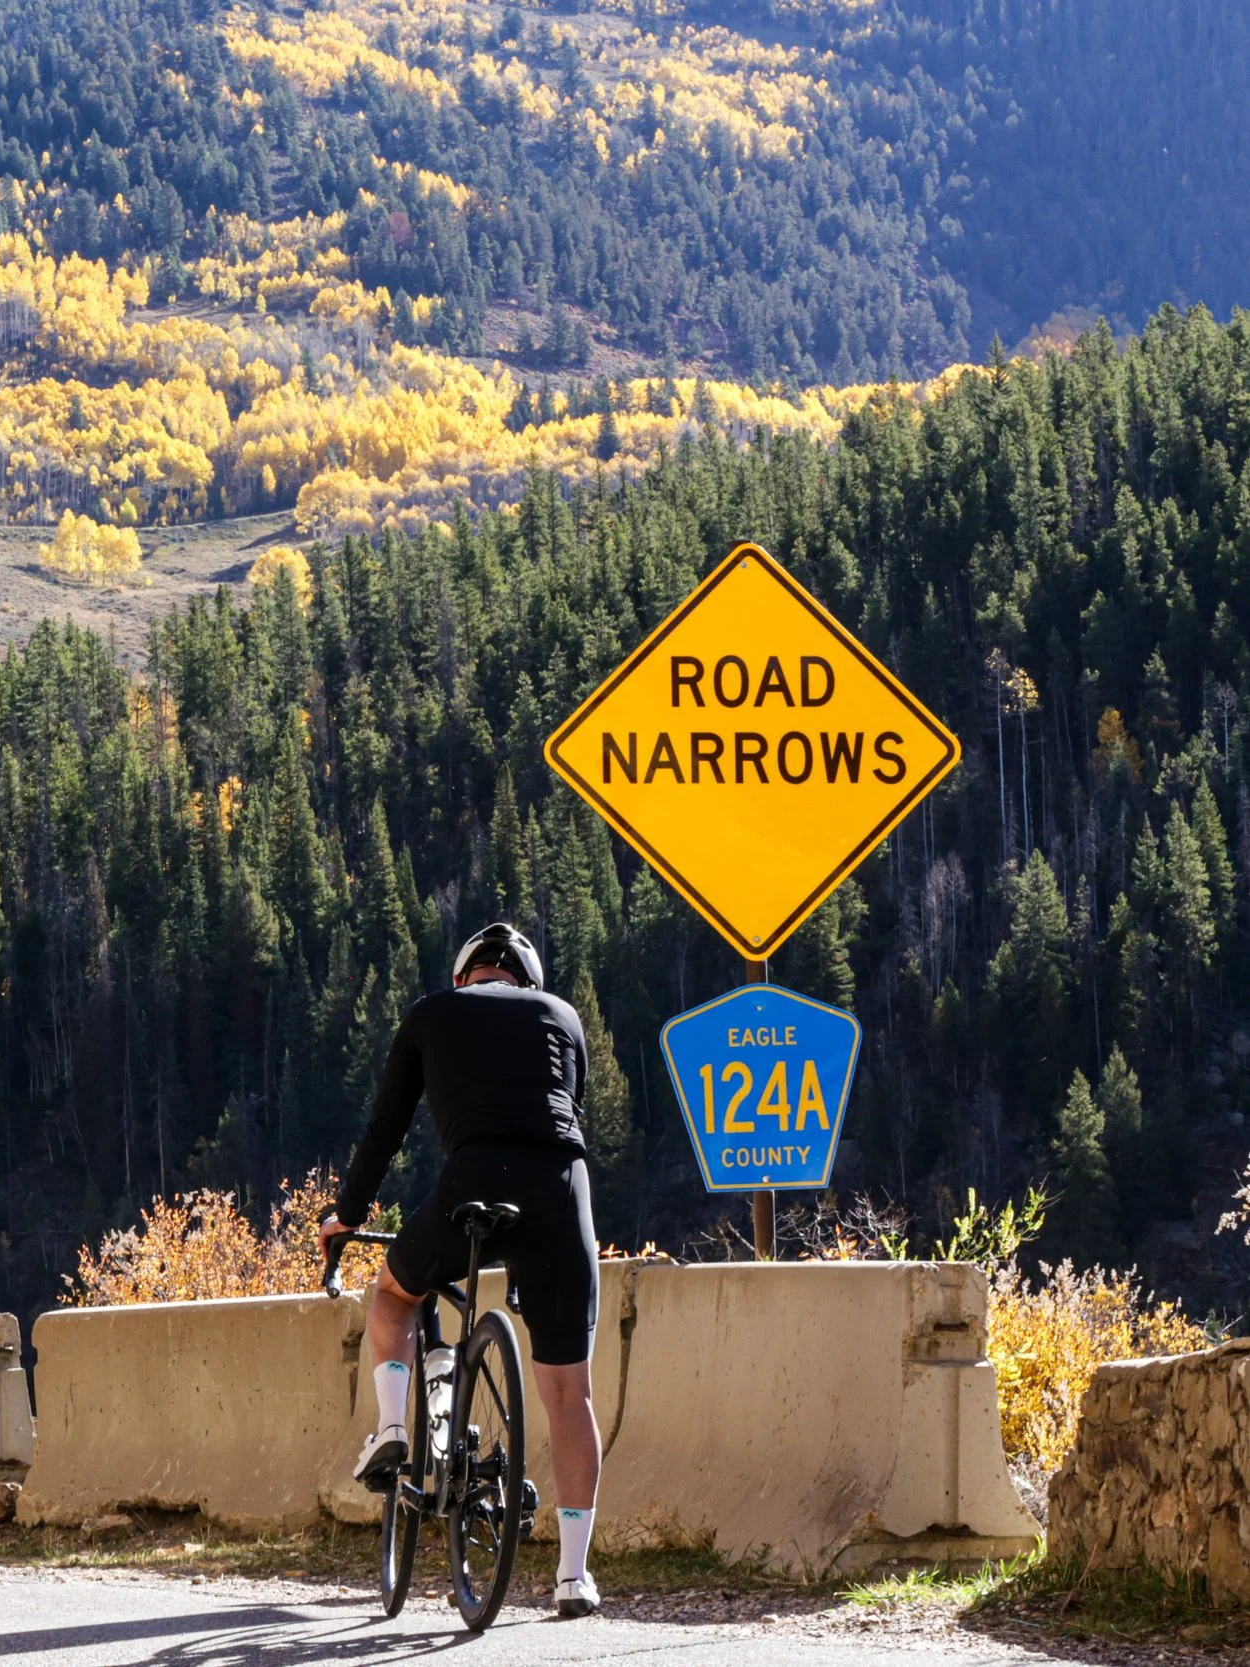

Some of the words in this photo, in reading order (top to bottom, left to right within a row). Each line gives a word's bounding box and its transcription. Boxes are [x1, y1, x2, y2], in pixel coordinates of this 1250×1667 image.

[670, 655, 835, 708] ROAD
[602, 731, 907, 785] NARROWS
[728, 1026, 797, 1047] EAGLE
[699, 1060, 830, 1134] 124A
[721, 1146, 811, 1168] COUNTY
